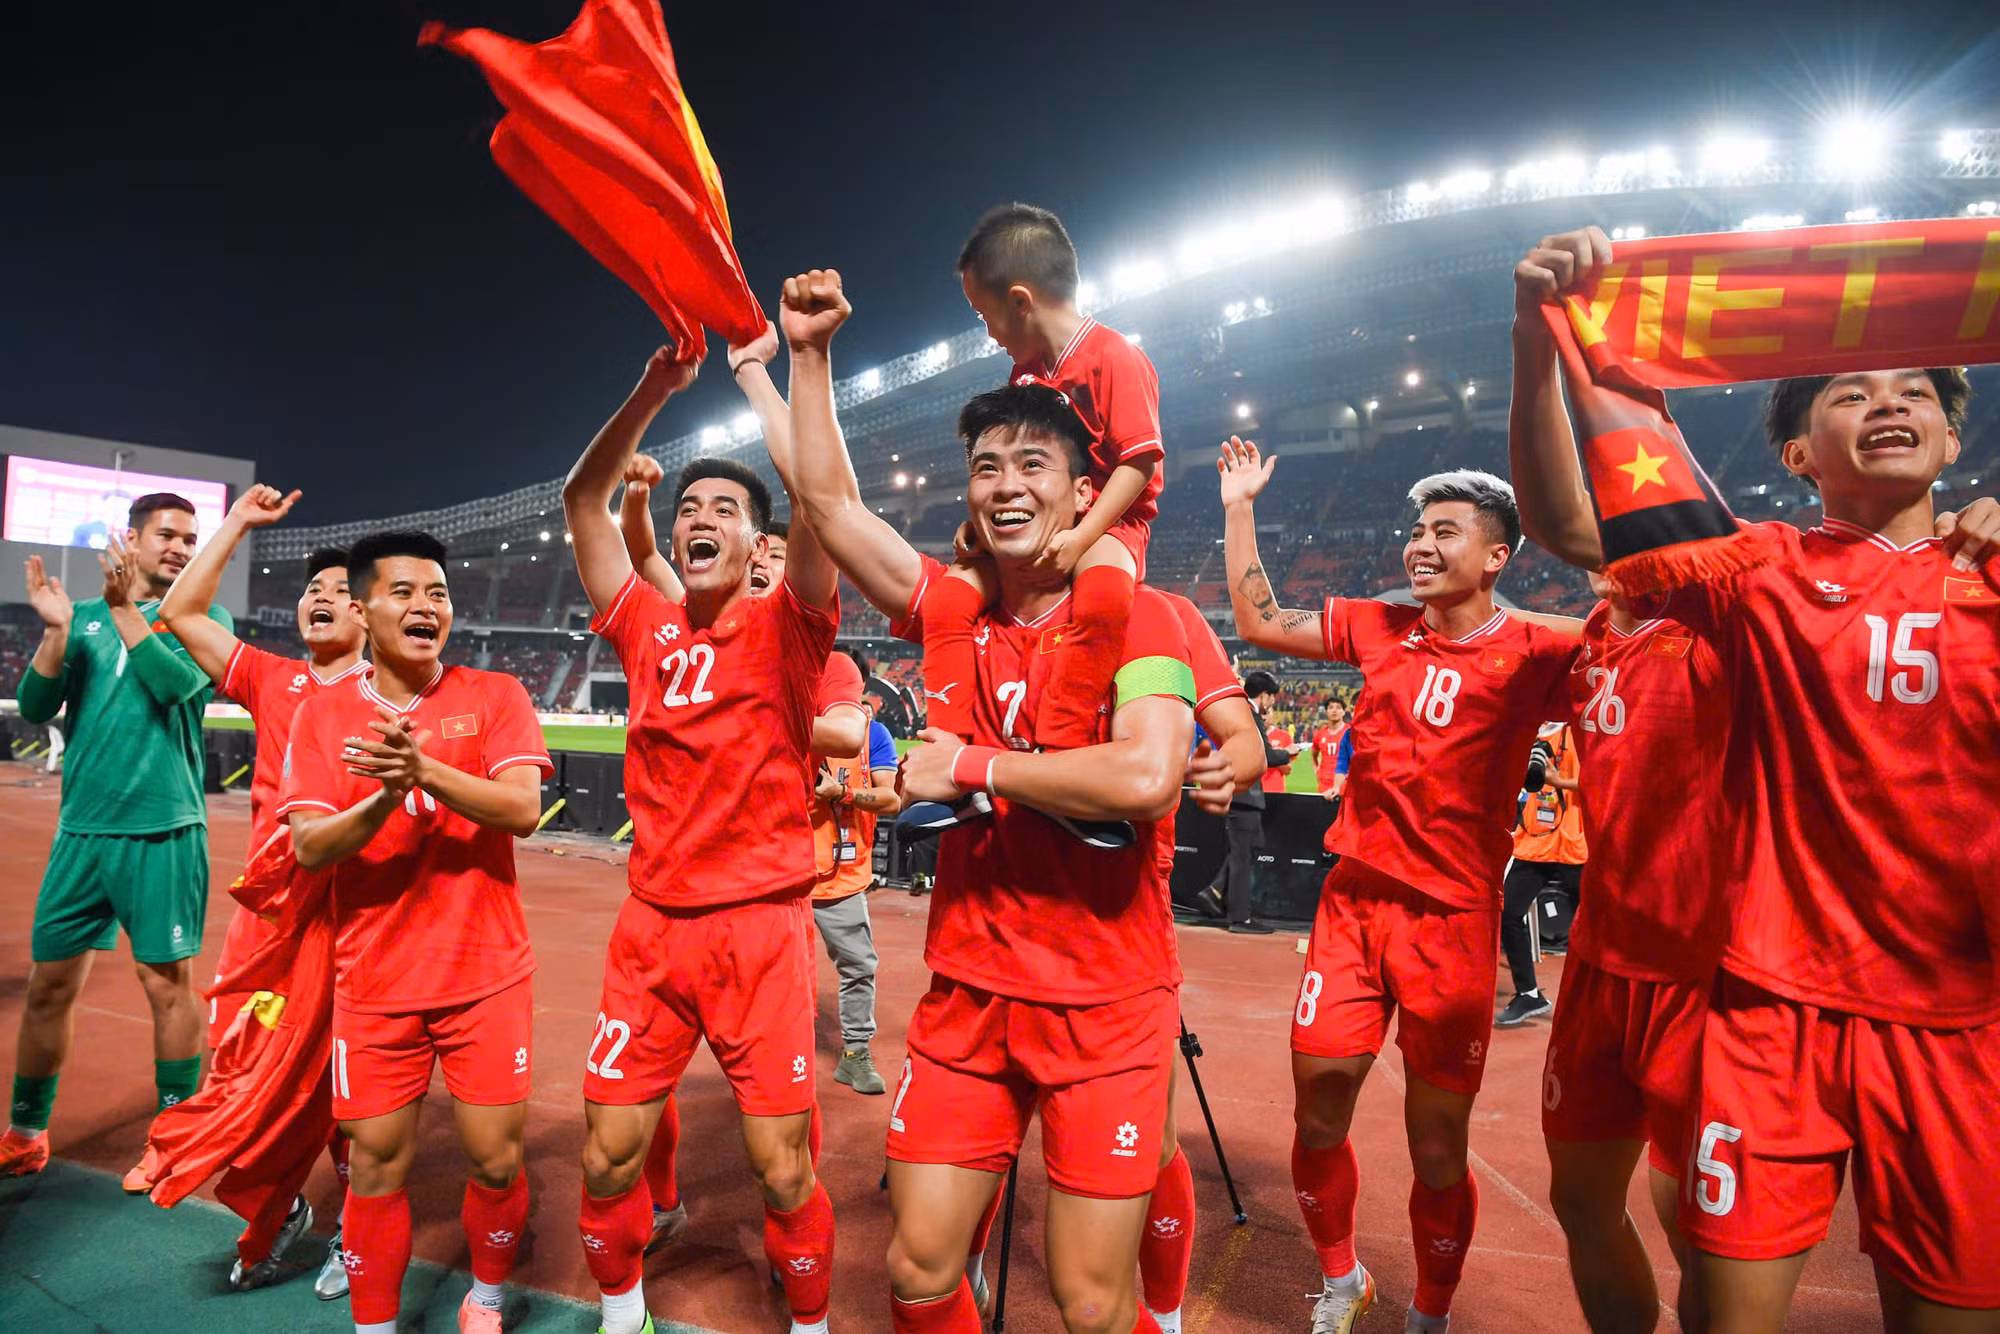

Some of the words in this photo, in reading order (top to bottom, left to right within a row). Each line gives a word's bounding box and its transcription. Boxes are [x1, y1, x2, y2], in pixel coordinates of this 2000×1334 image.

[1566, 237, 1926, 363] VIET
[661, 643, 715, 707] 22
[1864, 612, 1942, 704] 15
[1412, 664, 1462, 727] 18
[1579, 666, 1626, 735] 26
[586, 1011, 630, 1079] 22
